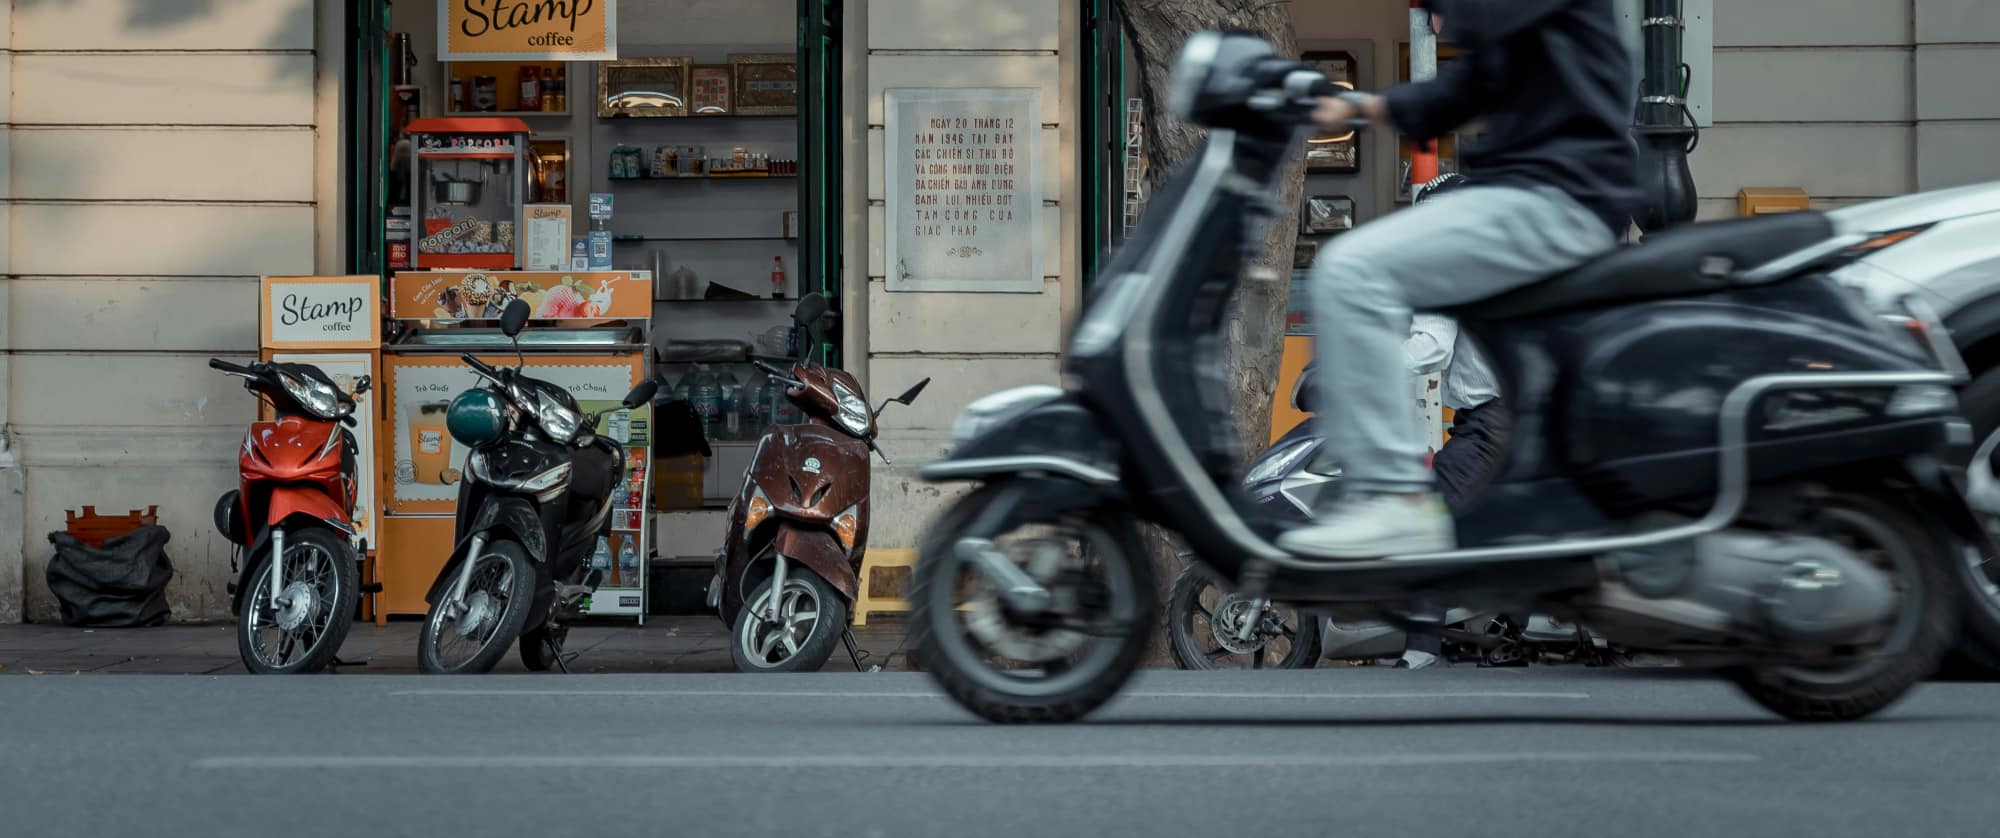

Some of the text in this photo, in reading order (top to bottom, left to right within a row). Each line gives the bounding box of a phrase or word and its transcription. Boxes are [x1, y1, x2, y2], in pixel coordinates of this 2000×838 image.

[462, 0, 593, 37] Stamp
[527, 32, 574, 46] coffee
[955, 118, 967, 129] 20
[1005, 118, 1014, 129] 12
[941, 133, 964, 145] 1946
[533, 208, 562, 218] Stamp
[281, 293, 363, 326] Stamp
[322, 322, 352, 332] coffee
[583, 383, 607, 393] Chanh
